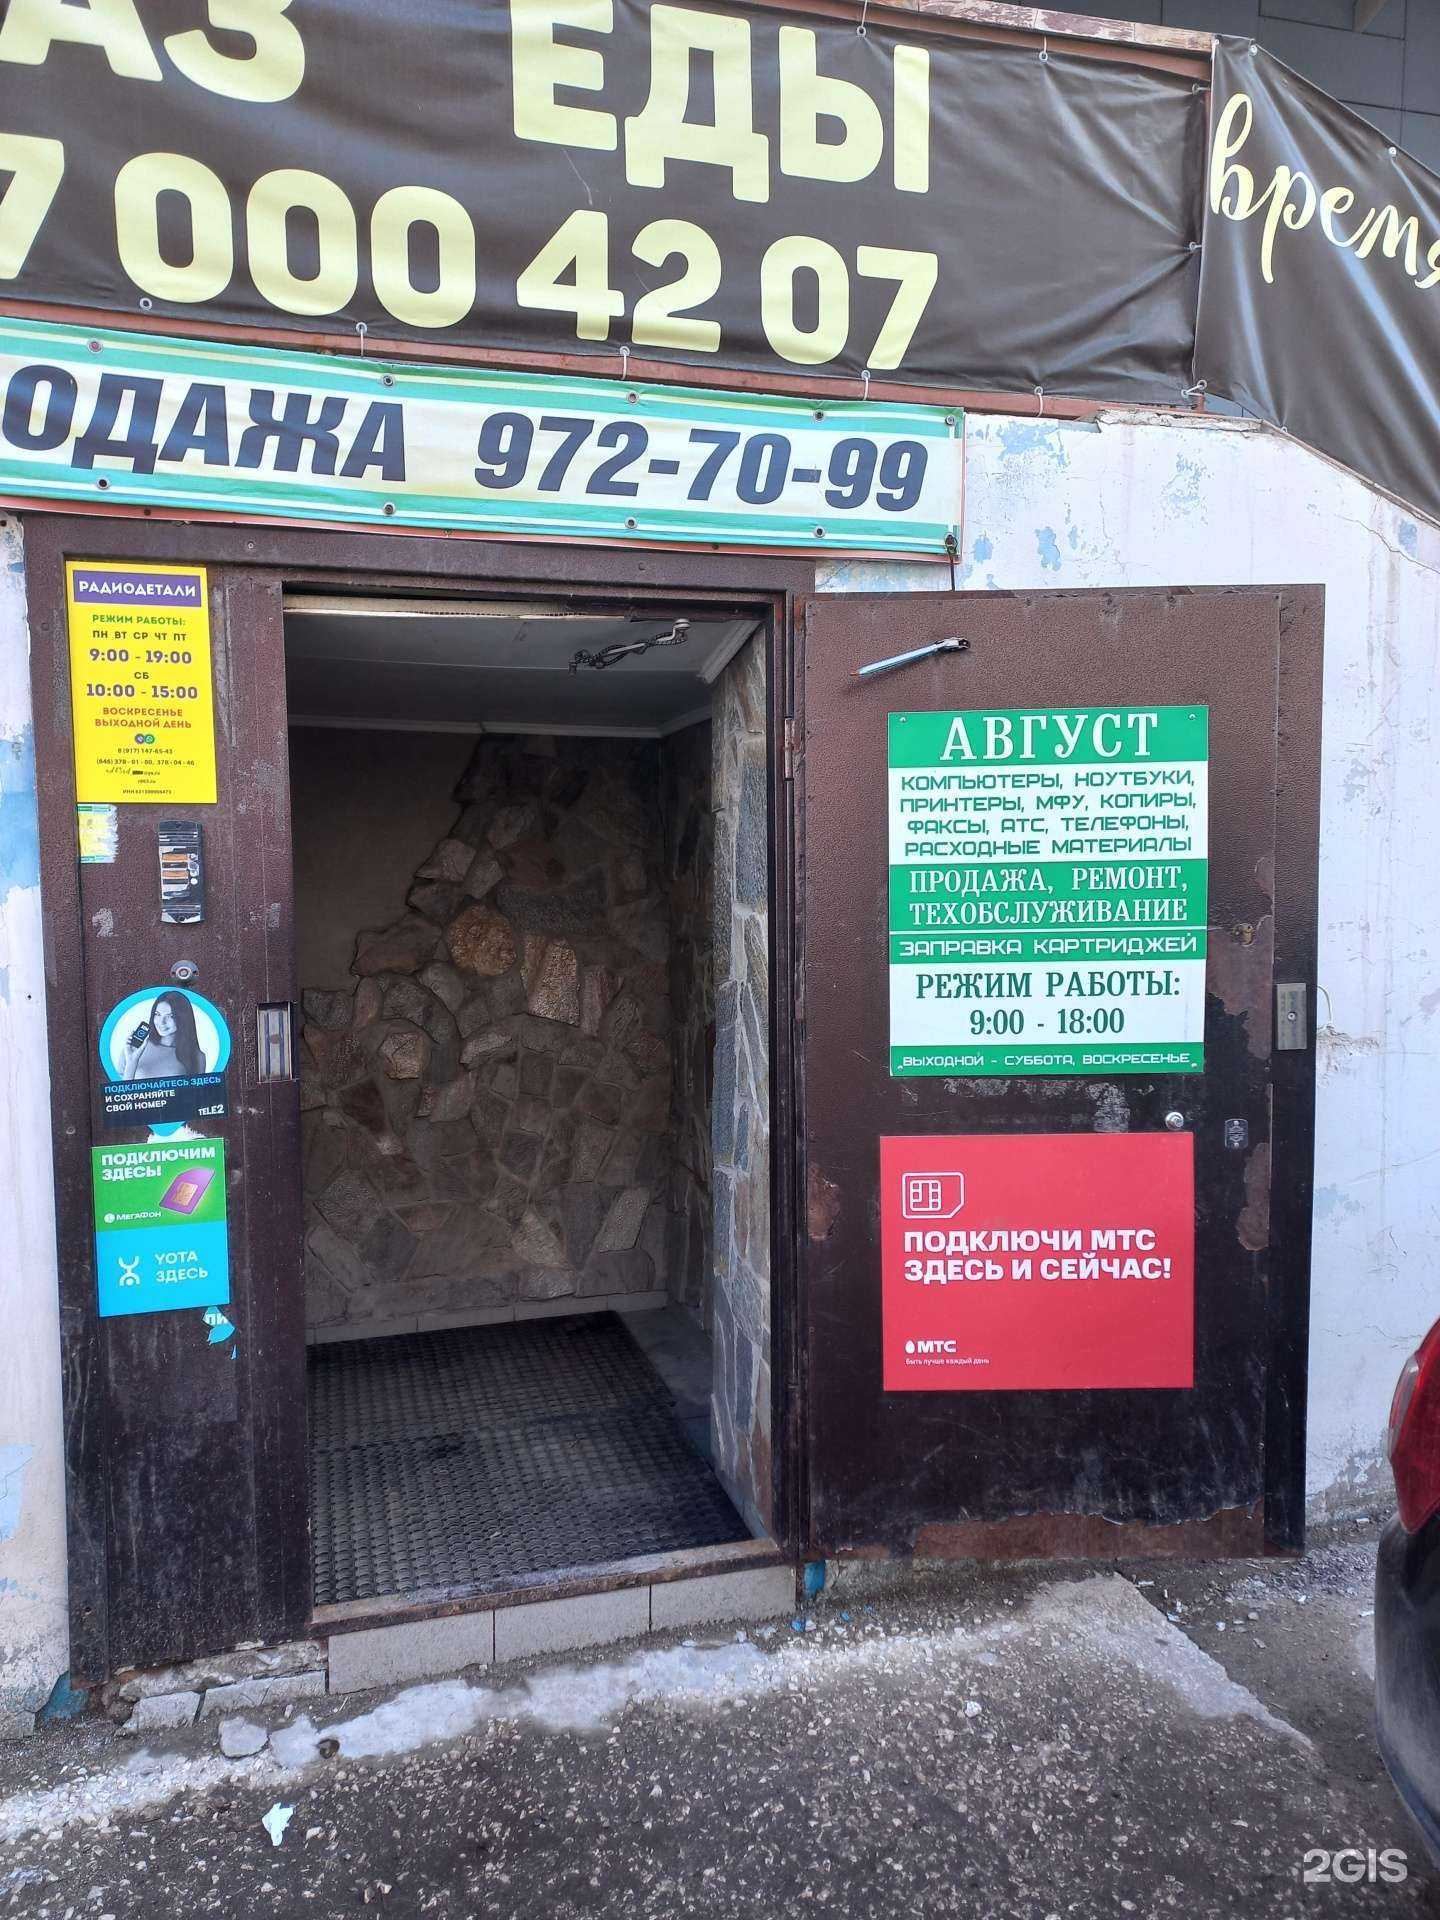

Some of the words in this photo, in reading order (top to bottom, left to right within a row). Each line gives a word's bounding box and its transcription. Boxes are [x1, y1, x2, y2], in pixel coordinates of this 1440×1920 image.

[511, 0, 930, 203] ЕДЫ
[114, 152, 475, 328] 000
[517, 210, 722, 353] 42
[761, 235, 938, 370] 07
[2, 364, 406, 482] ОДАЖА
[474, 411, 929, 511] 972-70-99
[79, 581, 196, 597] РАДИОДЕТАЛИ
[92, 614, 133, 624] РЕЖИМ
[136, 615, 186, 626] РАБОТЫ:
[92, 630, 108, 639] ПН
[114, 631, 127, 639] ВТ
[133, 632, 148, 640] СР
[155, 632, 167, 641] ЧТ
[173, 633, 187, 641] ПТ
[89, 648, 129, 662] 9:00
[145, 650, 192, 664] 19:00
[134, 671, 149, 680] СБ
[86, 683, 135, 697] 10:00
[151, 685, 198, 699] 15:00
[103, 707, 183, 717] ВОСКРЕСЕНЬЕ
[95, 718, 160, 728] ВЫХОДНОЙ
[163, 719, 192, 729] ДЕНЬ
[939, 712, 1158, 761] АВГУСТ
[901, 773, 1063, 791] КОМПЬЮТЕРЫ,
[1074, 770, 1195, 788] НОУТБУКИ,
[900, 796, 1025, 814] ПРИНТЕРЫ,
[1036, 794, 1088, 812] МФУ,
[1100, 792, 1196, 810] КОПИРЫ,
[907, 818, 990, 836] ФАКСЫ,
[1001, 817, 1048, 835] АТС,
[1060, 815, 1189, 833] ТЕЛЕФОНЫ,
[905, 840, 1040, 858] РАСХОДНЫЕ
[1052, 837, 1191, 854] МАТЕРИАЛЫ
[909, 868, 1053, 897] ПРОДАЖА,
[1071, 865, 1188, 892] РЕМОНТ,
[909, 898, 1188, 926] ТЕХОБСЛУЖИВАНИЕ
[899, 939, 1022, 957] ЗАПРАВКА
[1034, 933, 1197, 955] КАРТРИДЖЕЙ
[916, 972, 1032, 999] РЕЖИМ
[1046, 970, 1180, 997] РАБОТЫ:
[970, 1009, 1025, 1035] 9:00
[1057, 1008, 1125, 1034] 18:00
[903, 1052, 984, 1067] ВЫХОДНОЙ
[1004, 1055, 1075, 1067] СУББОТА,
[1082, 1053, 1190, 1065] ВОСКРЕСЕНЬЕ
[105, 1079, 188, 1093] ПОДКЛЮЧАЙТЕСЬ
[191, 1076, 221, 1088] ЗДЕСЬ
[105, 1095, 113, 1103] И
[114, 1089, 176, 1103] СОХРАНЯЙТЕ
[106, 1101, 133, 1112] СВОЙ
[134, 1100, 167, 1110] НОМЕР
[198, 1104, 224, 1116] TELE2
[101, 1147, 216, 1166] ПОДКЛЮЧИМ
[102, 1165, 162, 1182] ЗДЕСЬ!
[904, 1229, 1082, 1256] ПОДКЛЮЧИ
[1091, 1229, 1156, 1250] МТС
[155, 1250, 198, 1265] YOTA
[156, 1267, 208, 1283] ЗДЕСЬ
[904, 1258, 1004, 1285] ЗДЕСЬ
[1011, 1258, 1032, 1280] И
[1040, 1252, 1172, 1280] СЕЙЧАС!
[917, 1340, 957, 1353] МТС
